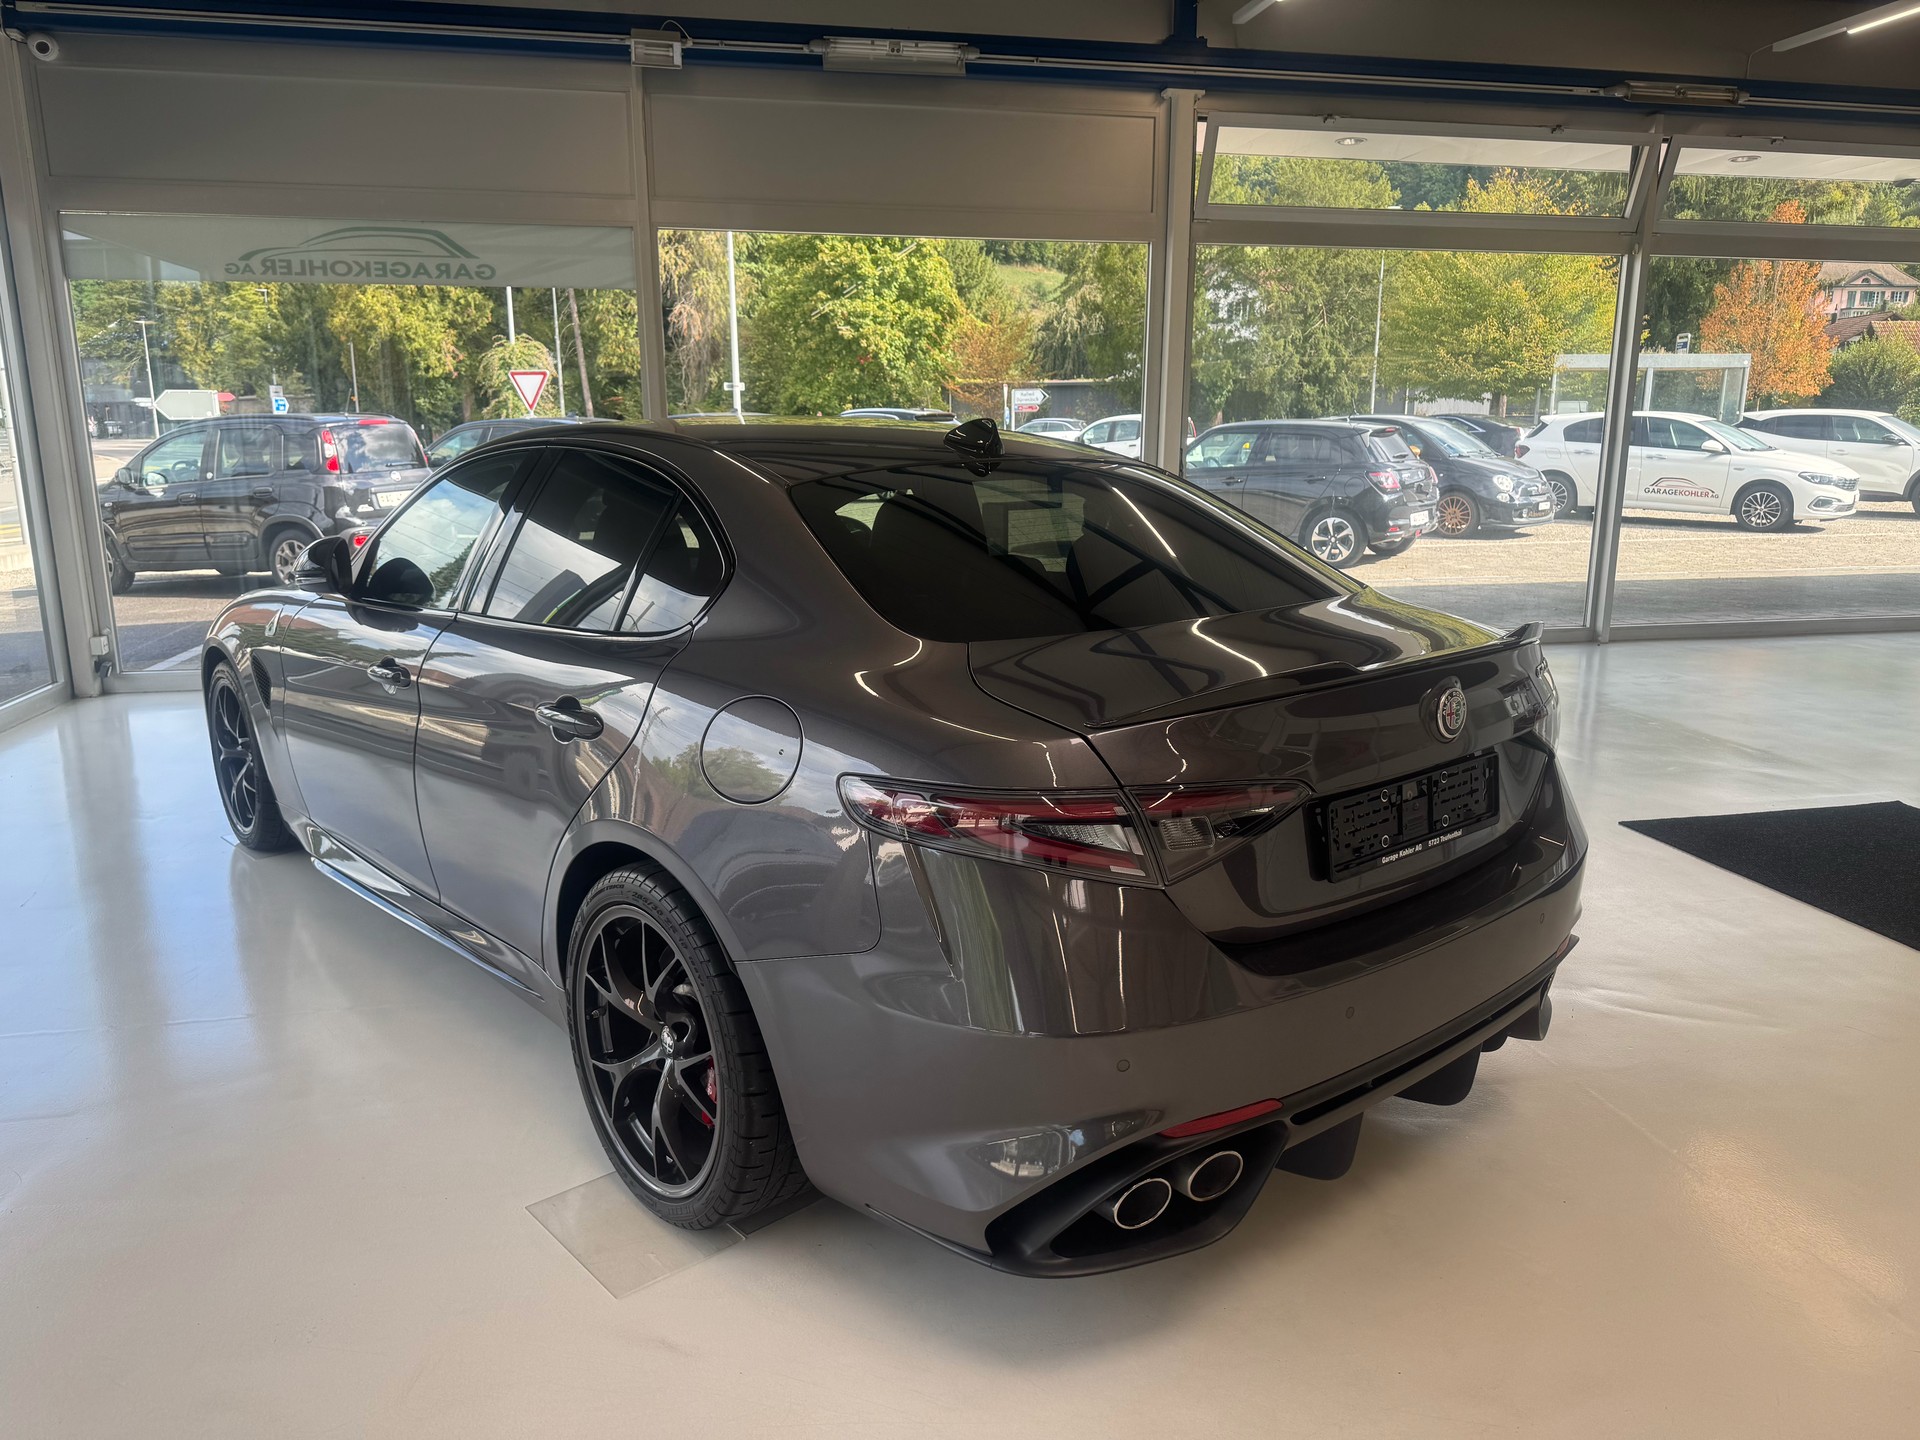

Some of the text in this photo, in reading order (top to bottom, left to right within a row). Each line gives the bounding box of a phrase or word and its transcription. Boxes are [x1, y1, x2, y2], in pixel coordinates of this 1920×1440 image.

[1644, 487, 1710, 498] GARAGEKOHLER
[1381, 854, 1399, 864] Garage
[1399, 847, 1415, 858] Kohler
[1415, 843, 1423, 852] AG
[1428, 837, 1440, 847] 5723
